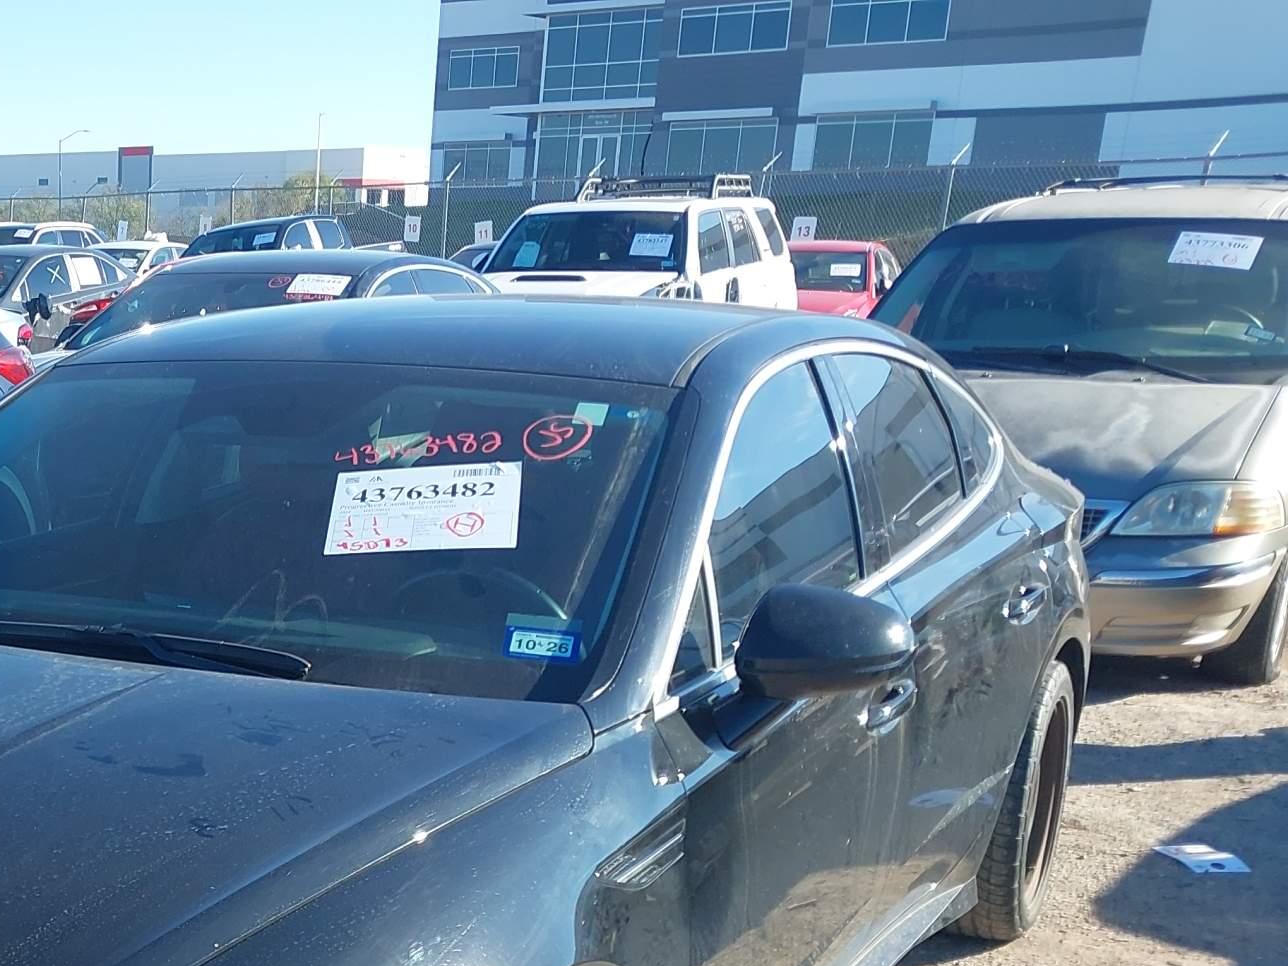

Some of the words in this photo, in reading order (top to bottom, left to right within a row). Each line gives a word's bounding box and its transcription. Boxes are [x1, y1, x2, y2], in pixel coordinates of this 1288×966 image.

[408, 223, 417, 233] 10
[797, 225, 810, 237] 13
[479, 229, 488, 239] 11
[352, 482, 496, 504] 43763482
